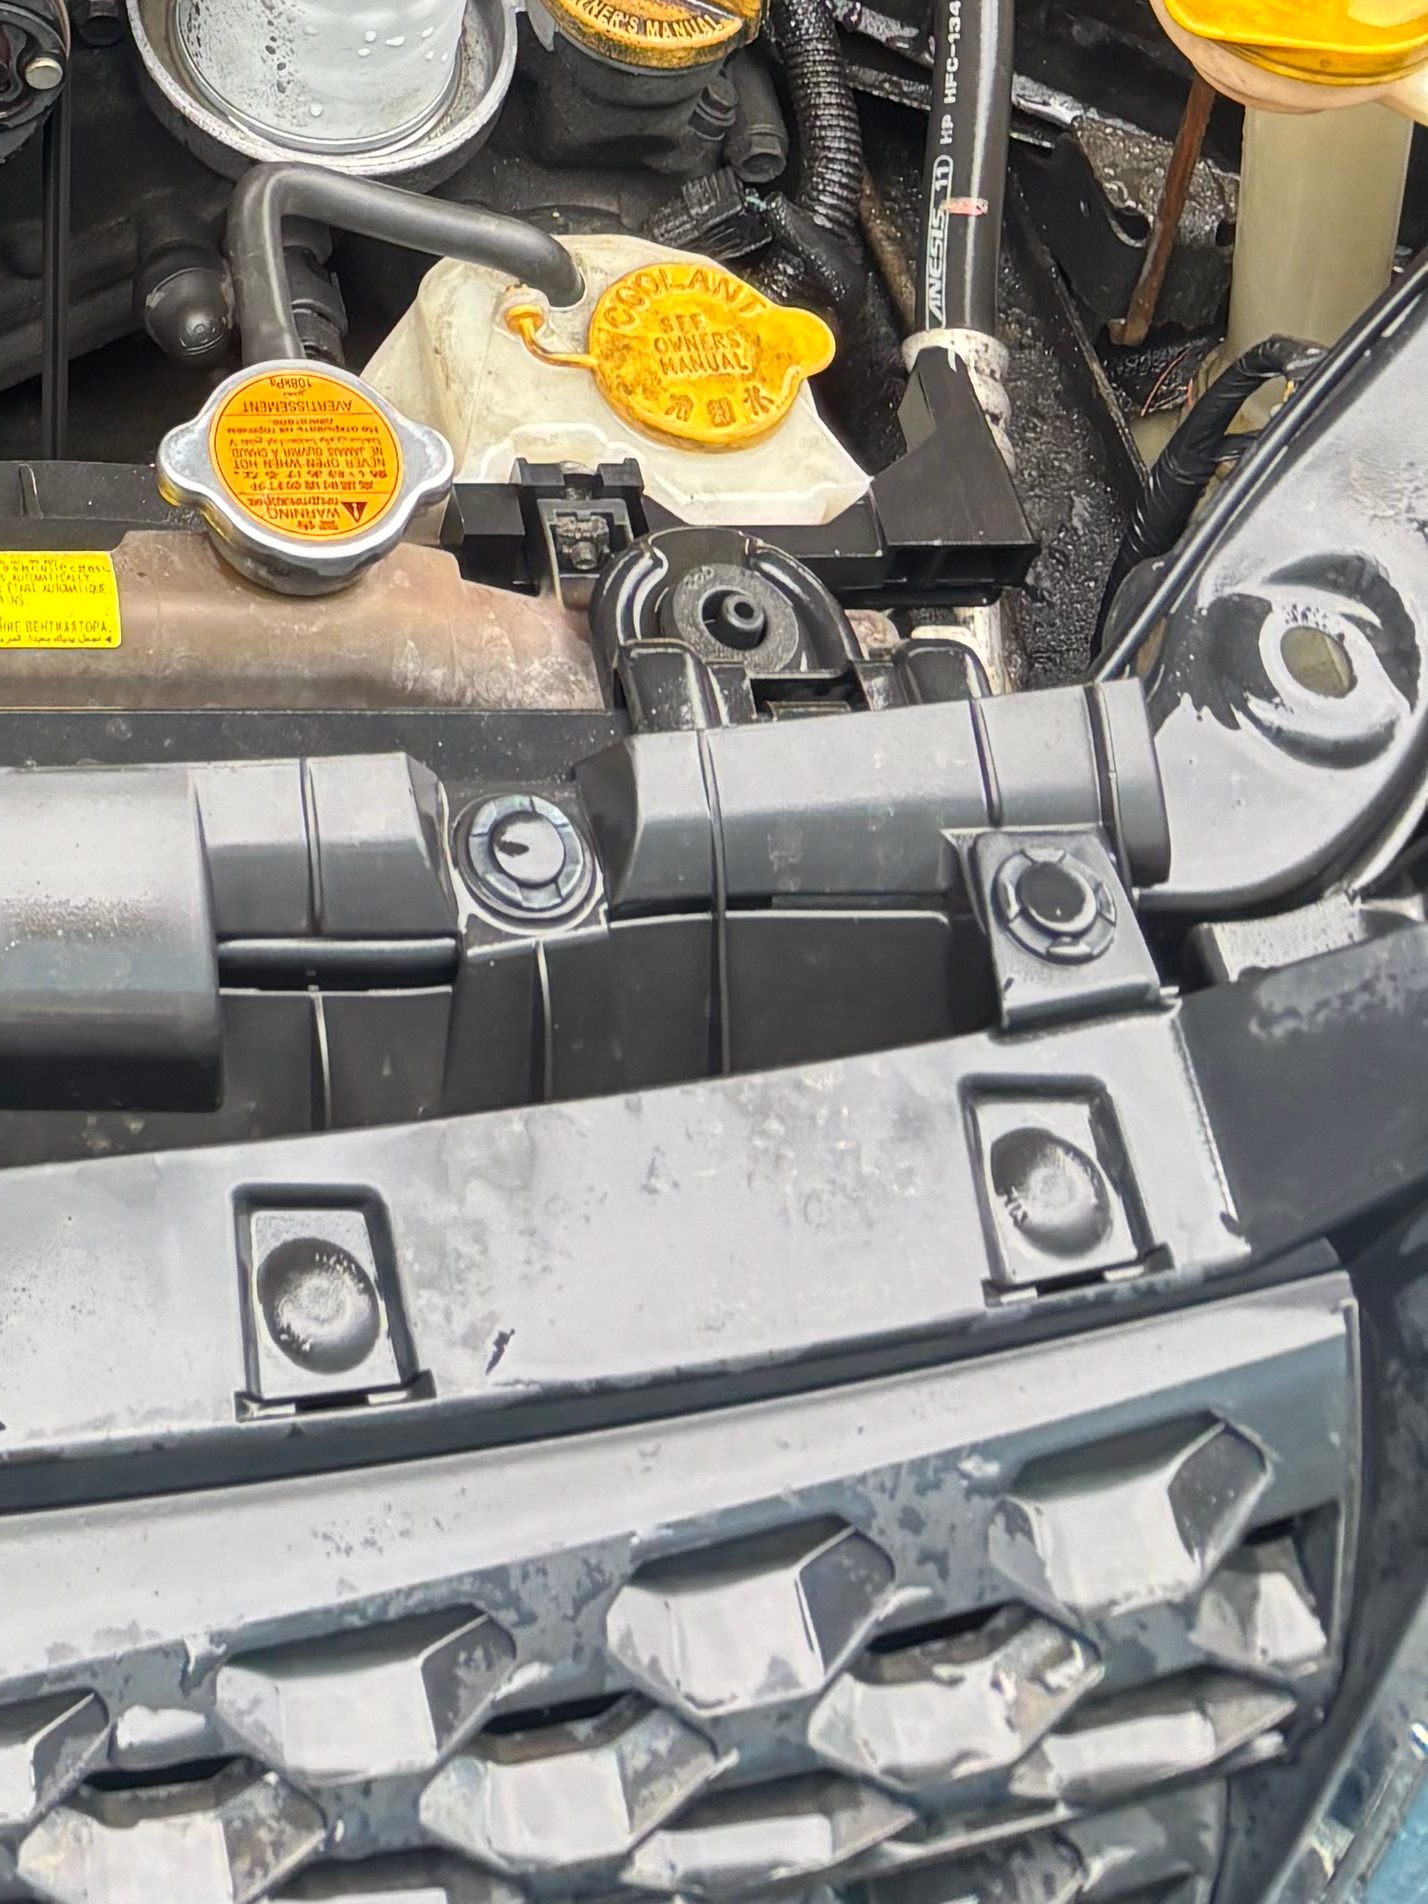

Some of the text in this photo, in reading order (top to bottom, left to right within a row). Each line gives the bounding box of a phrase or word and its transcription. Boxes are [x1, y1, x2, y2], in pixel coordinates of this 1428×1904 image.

[645, 14, 725, 41] MANUAL
[939, 113, 955, 145] HP
[933, 165, 951, 192] 11
[603, 268, 767, 328] COOLANT
[659, 312, 707, 334] SEE
[659, 351, 752, 377] MANUAL
[269, 377, 314, 388] 108kPa
[243, 400, 354, 414] AVERTISSEMENT
[326, 446, 365, 457] JAMAIS
[233, 458, 386, 470] NEVER OPEN WHEN HOT
